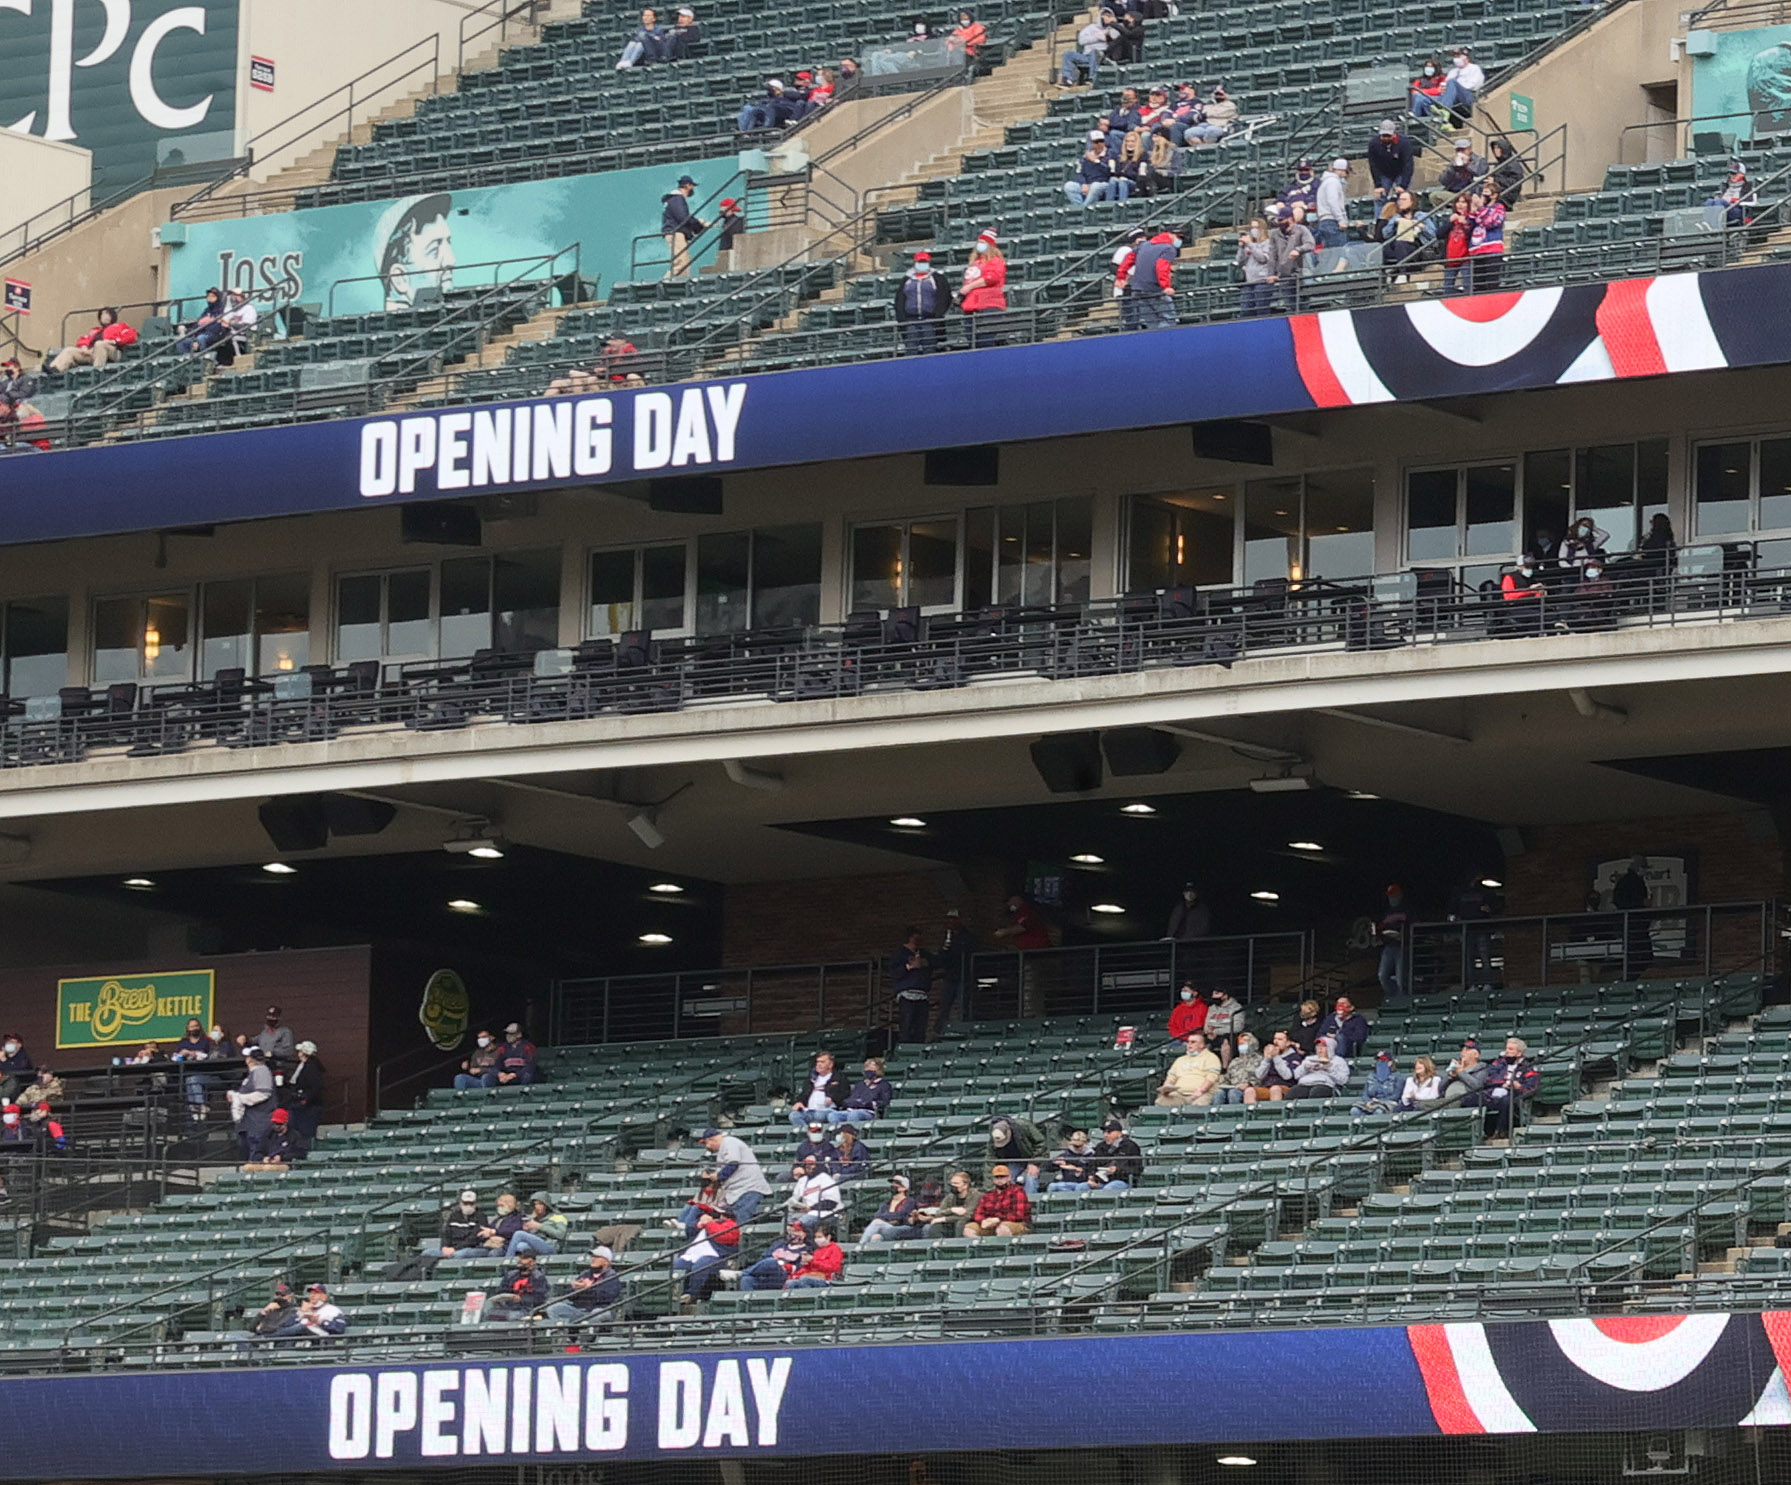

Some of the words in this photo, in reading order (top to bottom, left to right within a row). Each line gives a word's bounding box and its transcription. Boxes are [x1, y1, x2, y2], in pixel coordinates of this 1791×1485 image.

[359, 398, 613, 498] OPENING
[633, 383, 748, 471] DAY
[69, 1001, 92, 1023] THE
[92, 980, 157, 1041] Brew
[156, 995, 202, 1017] KETTLE
[328, 1362, 630, 1461] OPENING
[657, 1357, 793, 1450] DAY
